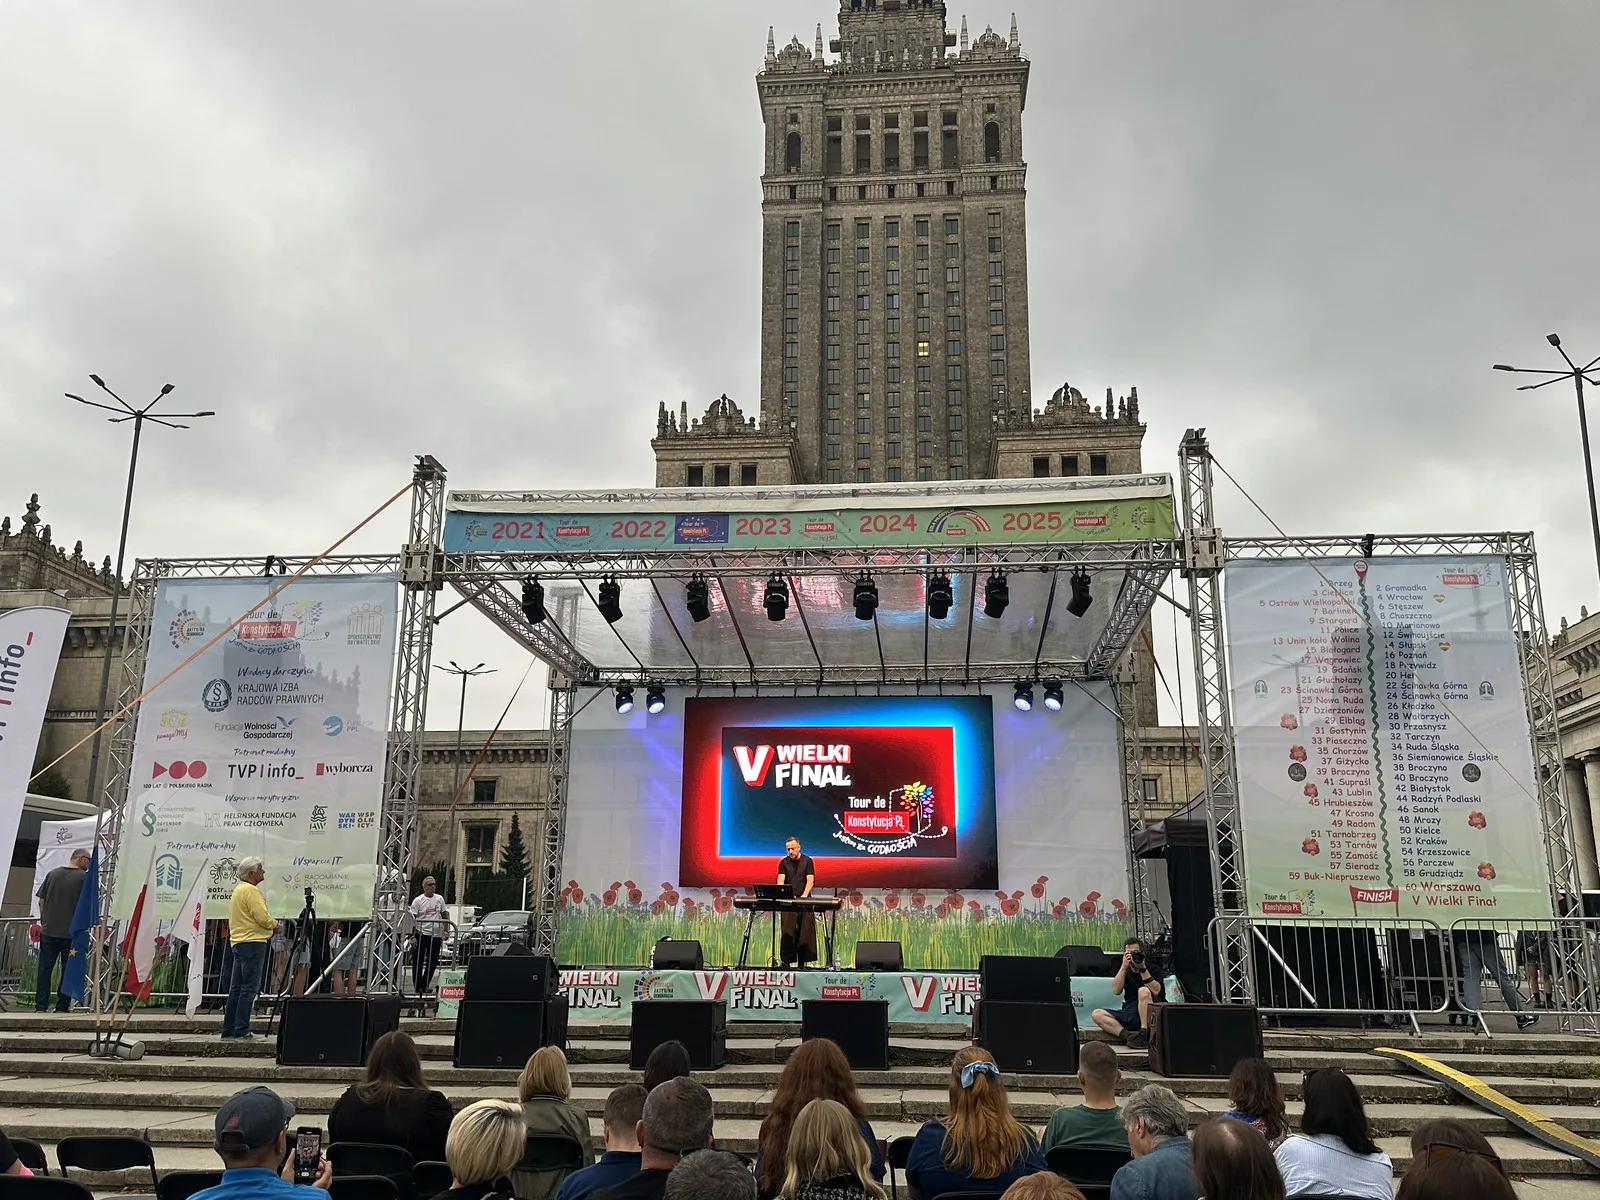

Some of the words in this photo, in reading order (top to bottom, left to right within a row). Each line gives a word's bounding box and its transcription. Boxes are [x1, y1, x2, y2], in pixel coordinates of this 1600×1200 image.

[859, 514, 917, 532] 2024
[1002, 512, 1061, 531] 2025
[492, 522, 544, 539] 2021
[612, 520, 666, 538] 2022
[736, 518, 791, 535] 2023
[267, 610, 278, 618] de
[242, 625, 281, 637] Konstytucja
[282, 625, 292, 633] PL
[1398, 631, 1445, 640] Świnoujście
[1316, 677, 1363, 685] Głuchołazy
[238, 684, 277, 693] KRAJOWA
[280, 683, 299, 692] IZBA
[237, 695, 271, 705] RADCÓW
[274, 695, 323, 704] PRAWNYCH
[1340, 717, 1365, 726] Elbląg
[1403, 713, 1449, 721] Wałbrzych
[214, 723, 243, 731] Fundacja
[245, 722, 277, 730] Wolności
[1403, 723, 1446, 731] Przasnysz
[244, 731, 293, 740] Gospodarczej
[1330, 727, 1366, 736] Gostynin
[1405, 733, 1440, 742] Tarczyn
[1431, 741, 1459, 752] Śląska
[776, 745, 852, 764] WIELKI
[1468, 751, 1498, 762] Śląskie
[325, 762, 373, 776] wyborcza
[733, 745, 774, 786] V
[1408, 764, 1447, 773] Broczyno
[228, 764, 257, 779] TVP
[1331, 768, 1370, 777] Broczyno
[1339, 778, 1371, 787] Supraśl
[1410, 785, 1451, 794] Białystok
[848, 796, 871, 808] Tour
[874, 796, 886, 808] de
[1324, 799, 1373, 807] Hrubieszów
[1412, 795, 1443, 804] Radzyń
[1446, 795, 1481, 803] Podlaski
[262, 812, 297, 820] FUNDACJA
[1414, 816, 1441, 825] Mrozy
[848, 815, 893, 830] Konstytucja
[895, 816, 904, 827] PL
[1347, 820, 1375, 828] Radom
[1326, 831, 1376, 839] Tarnobrzeg
[1416, 837, 1447, 845] Kraków
[167, 842, 200, 850] Patronat
[1417, 848, 1470, 856] Krzeszowice
[332, 856, 343, 865] IT
[1345, 862, 1379, 870] Sieradz
[1304, 872, 1380, 881] Buk-Niepruszewo
[1419, 869, 1464, 879] Grudziądz
[1405, 883, 1417, 891] 60
[1421, 882, 1481, 892] Warszawa
[1357, 891, 1392, 900] FINISH
[1412, 896, 1420, 905] V
[1426, 895, 1463, 906] Wielki
[1468, 896, 1497, 906] Finał
[1264, 903, 1291, 911] Konstytucja
[557, 971, 620, 987] WIELKI
[732, 972, 797, 988] WIELKI
[825, 977, 839, 985] Tour
[693, 971, 728, 1000] V
[823, 989, 851, 997] Konstytucja
[901, 975, 938, 1012] V
